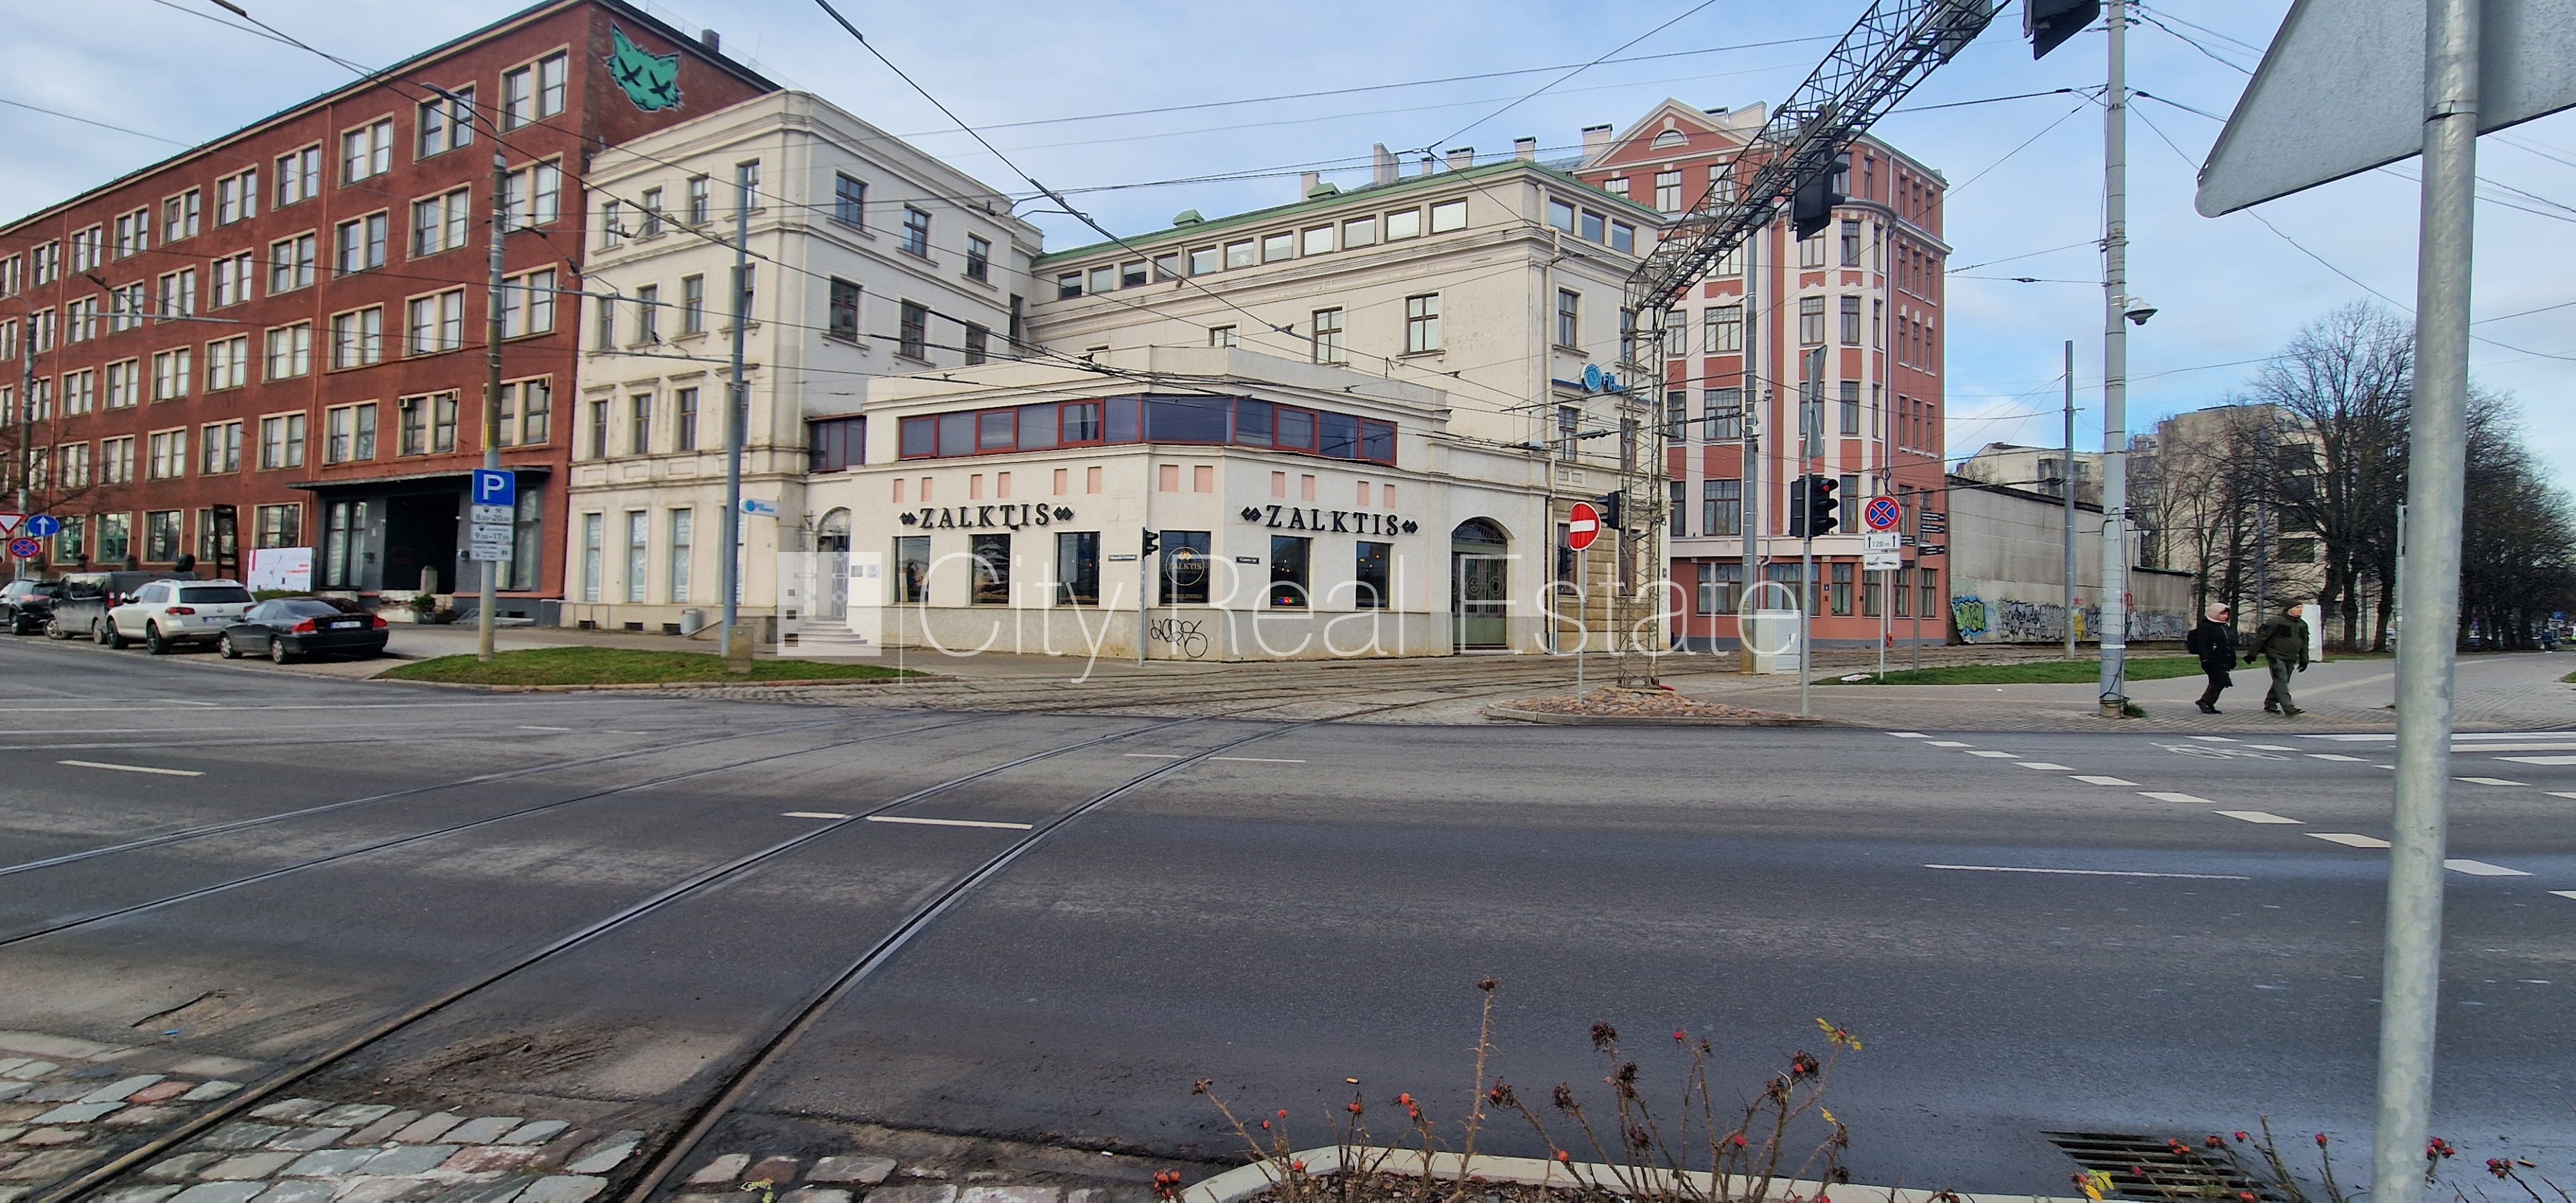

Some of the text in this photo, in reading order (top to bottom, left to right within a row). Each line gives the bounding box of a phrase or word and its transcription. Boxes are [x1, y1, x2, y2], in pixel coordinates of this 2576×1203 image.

[483, 474, 505, 500] P
[919, 503, 1051, 529] ZALKTIS
[1266, 505, 1399, 535] ZALKTIS
[1168, 562, 1202, 571] ZALKTIS
